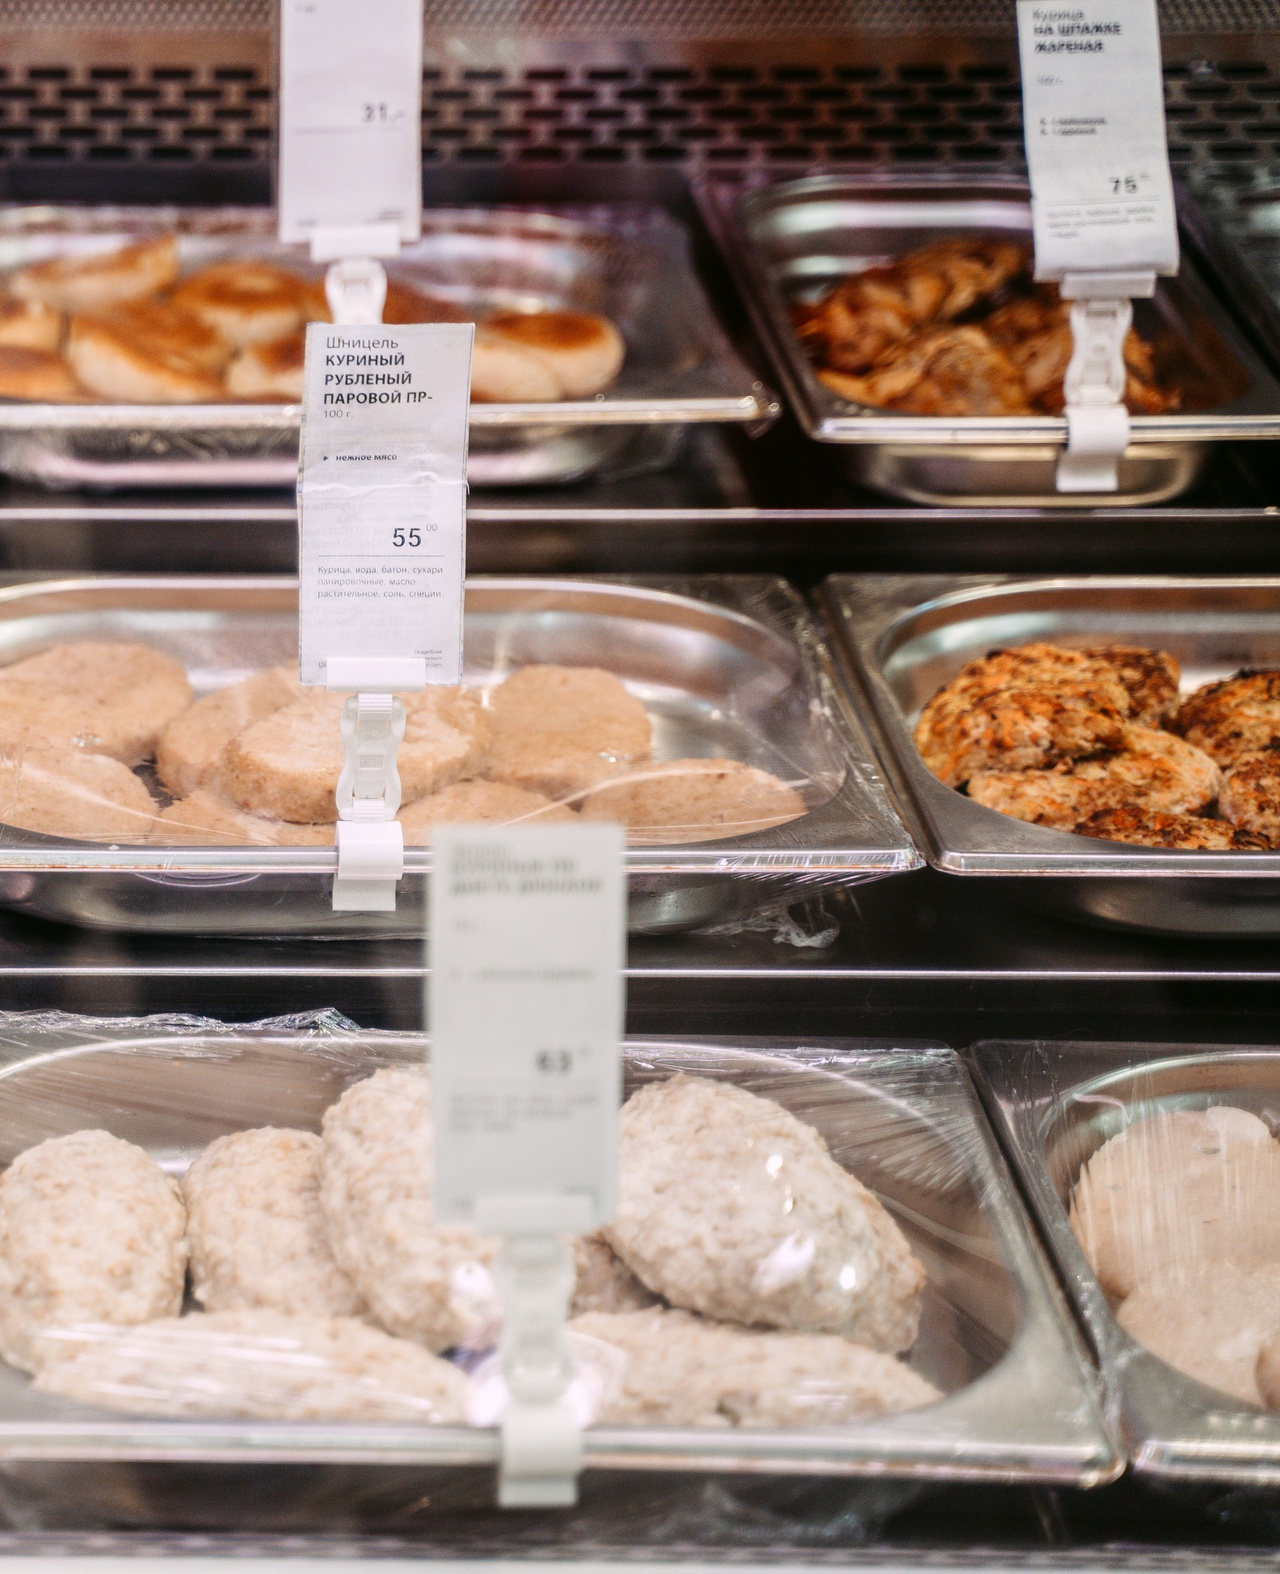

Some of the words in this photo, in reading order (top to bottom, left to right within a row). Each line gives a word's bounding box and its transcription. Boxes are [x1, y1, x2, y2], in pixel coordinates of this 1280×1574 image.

[1109, 175, 1138, 194] 75
[326, 336, 399, 351] Шницель
[326, 352, 405, 366] КУРИНЫЙ
[324, 371, 412, 385] РУБЛЕНЫЙ
[323, 390, 402, 404] ПАРОВОЙ
[406, 391, 433, 403] ПР-
[323, 410, 343, 418] 100
[392, 528, 422, 547] 55
[317, 566, 352, 574] Курица,
[381, 566, 409, 574] батон,
[317, 578, 386, 586] панировочные,
[317, 590, 380, 598] растительное,
[384, 590, 406, 598] соль,
[409, 590, 443, 598] специи.
